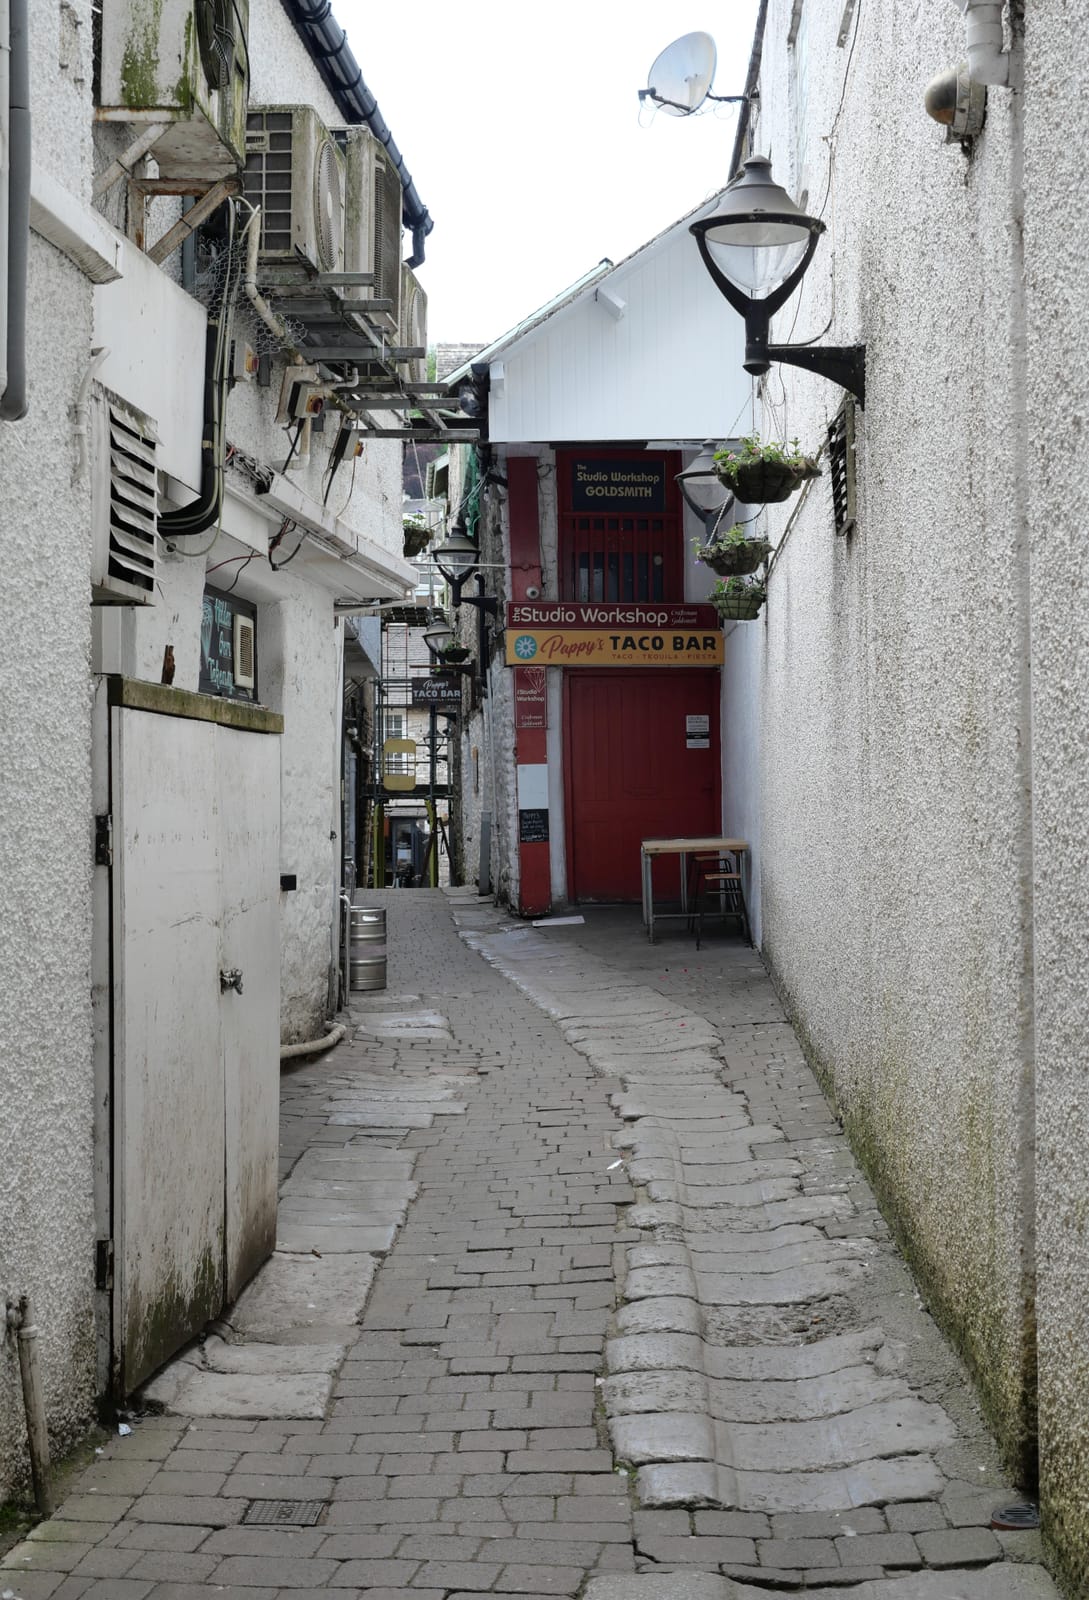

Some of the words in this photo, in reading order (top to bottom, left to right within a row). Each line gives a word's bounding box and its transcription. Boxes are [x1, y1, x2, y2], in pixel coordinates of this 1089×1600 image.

[577, 472, 608, 481] Studio
[611, 472, 660, 484] Workshop
[585, 486, 652, 497] GOLDSMITH
[520, 607, 576, 622] Studio
[580, 607, 668, 627] Workshop
[540, 634, 605, 659] Pappy's
[609, 636, 664, 651] TACO
[672, 636, 717, 651] BAR
